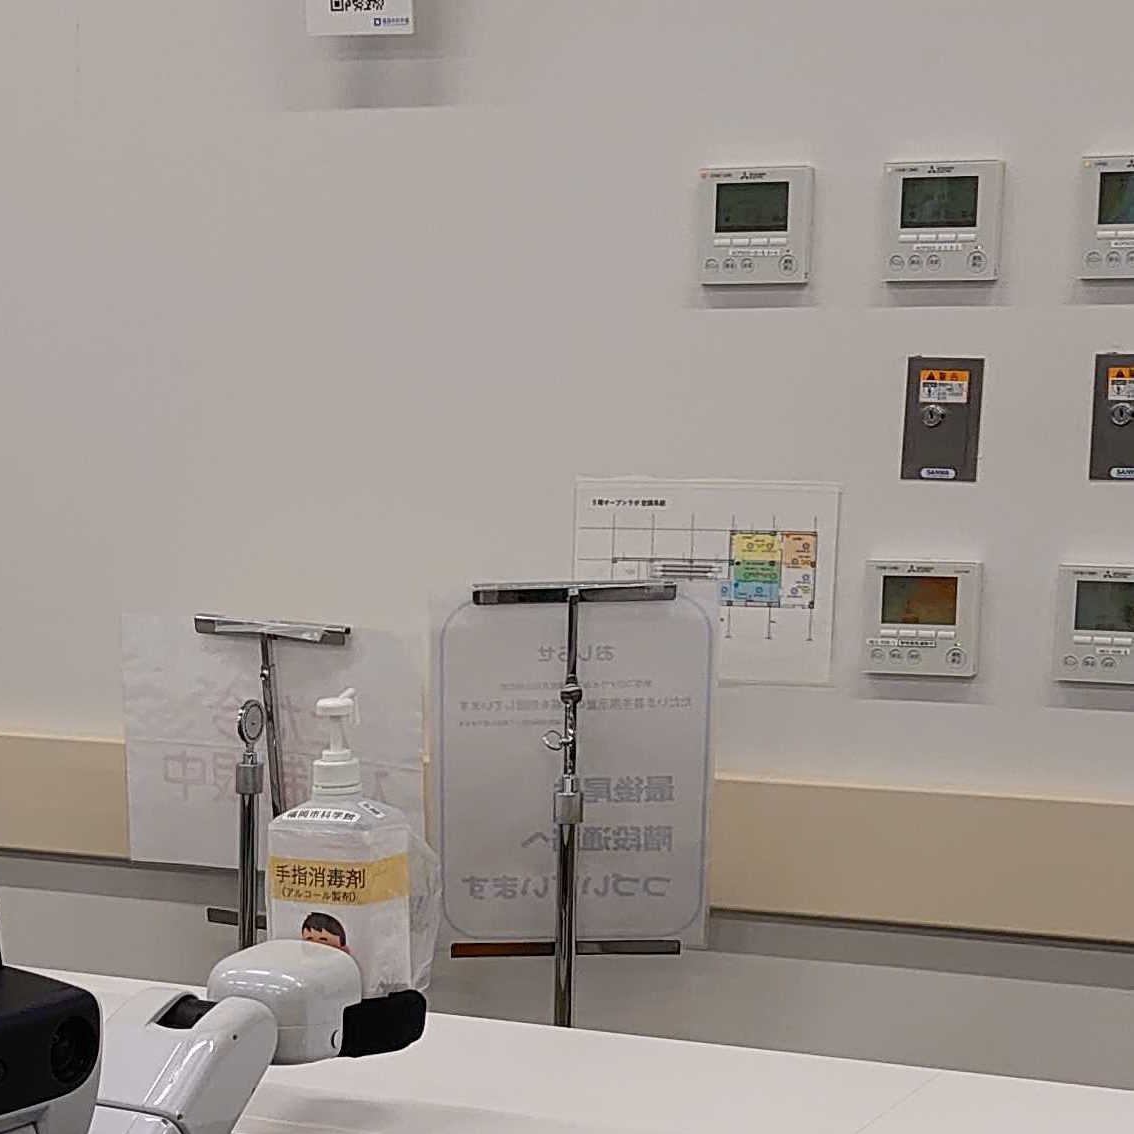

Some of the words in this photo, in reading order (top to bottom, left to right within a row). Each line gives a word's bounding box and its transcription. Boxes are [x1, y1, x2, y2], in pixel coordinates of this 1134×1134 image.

[276, 864, 366, 889] 手指消毒剤
